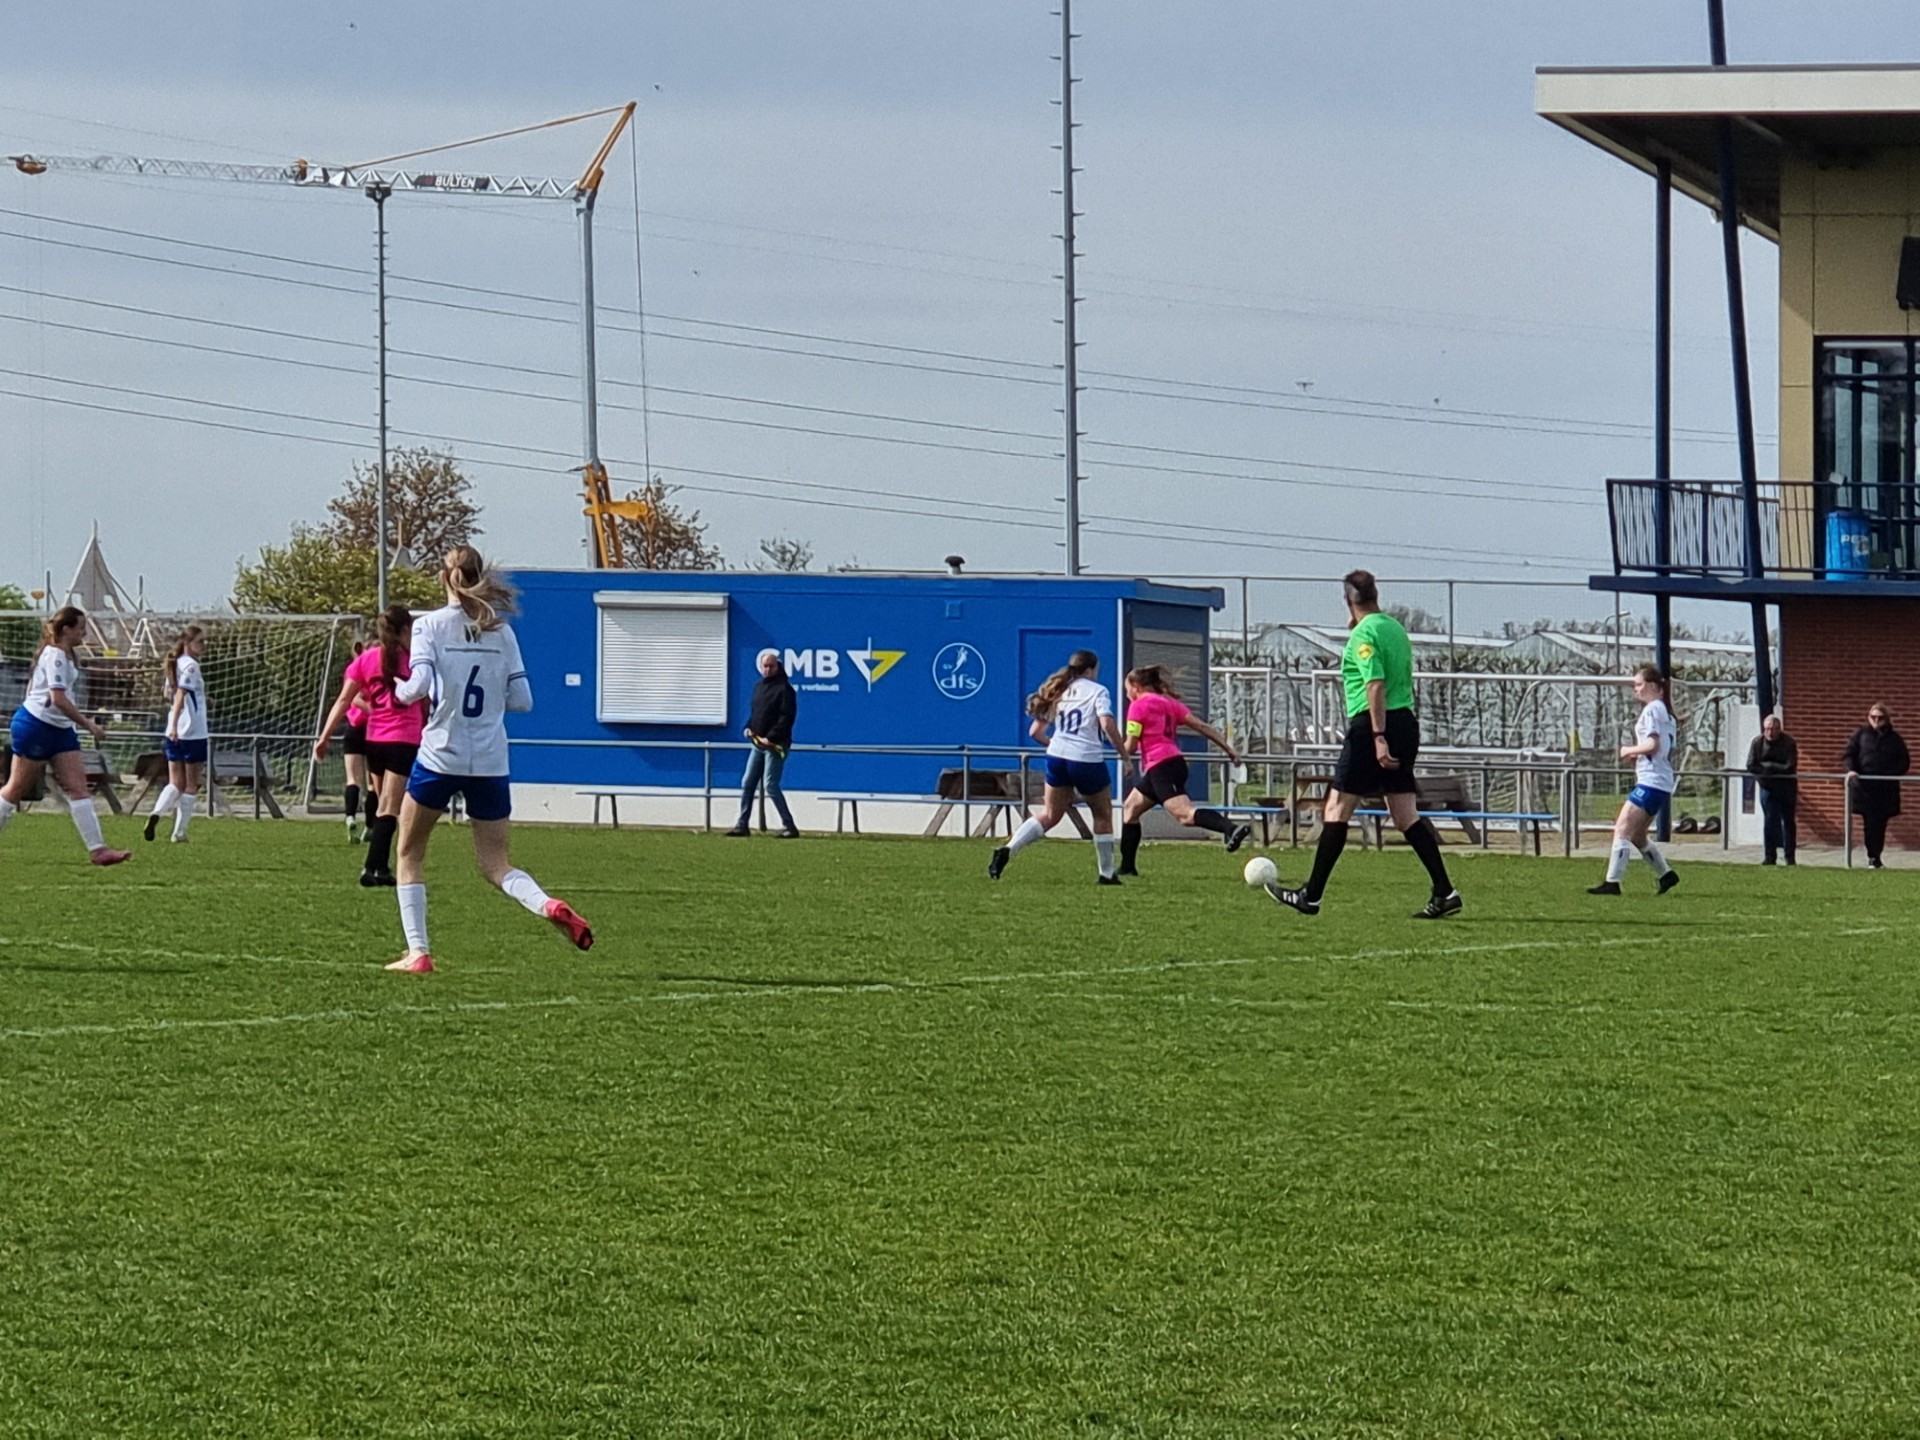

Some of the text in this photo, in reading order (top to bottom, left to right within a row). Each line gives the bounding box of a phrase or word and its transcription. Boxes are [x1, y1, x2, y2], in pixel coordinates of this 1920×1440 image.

[462, 665, 485, 718] 6
[940, 673, 979, 689] dfs
[1059, 708, 1082, 735] 10
